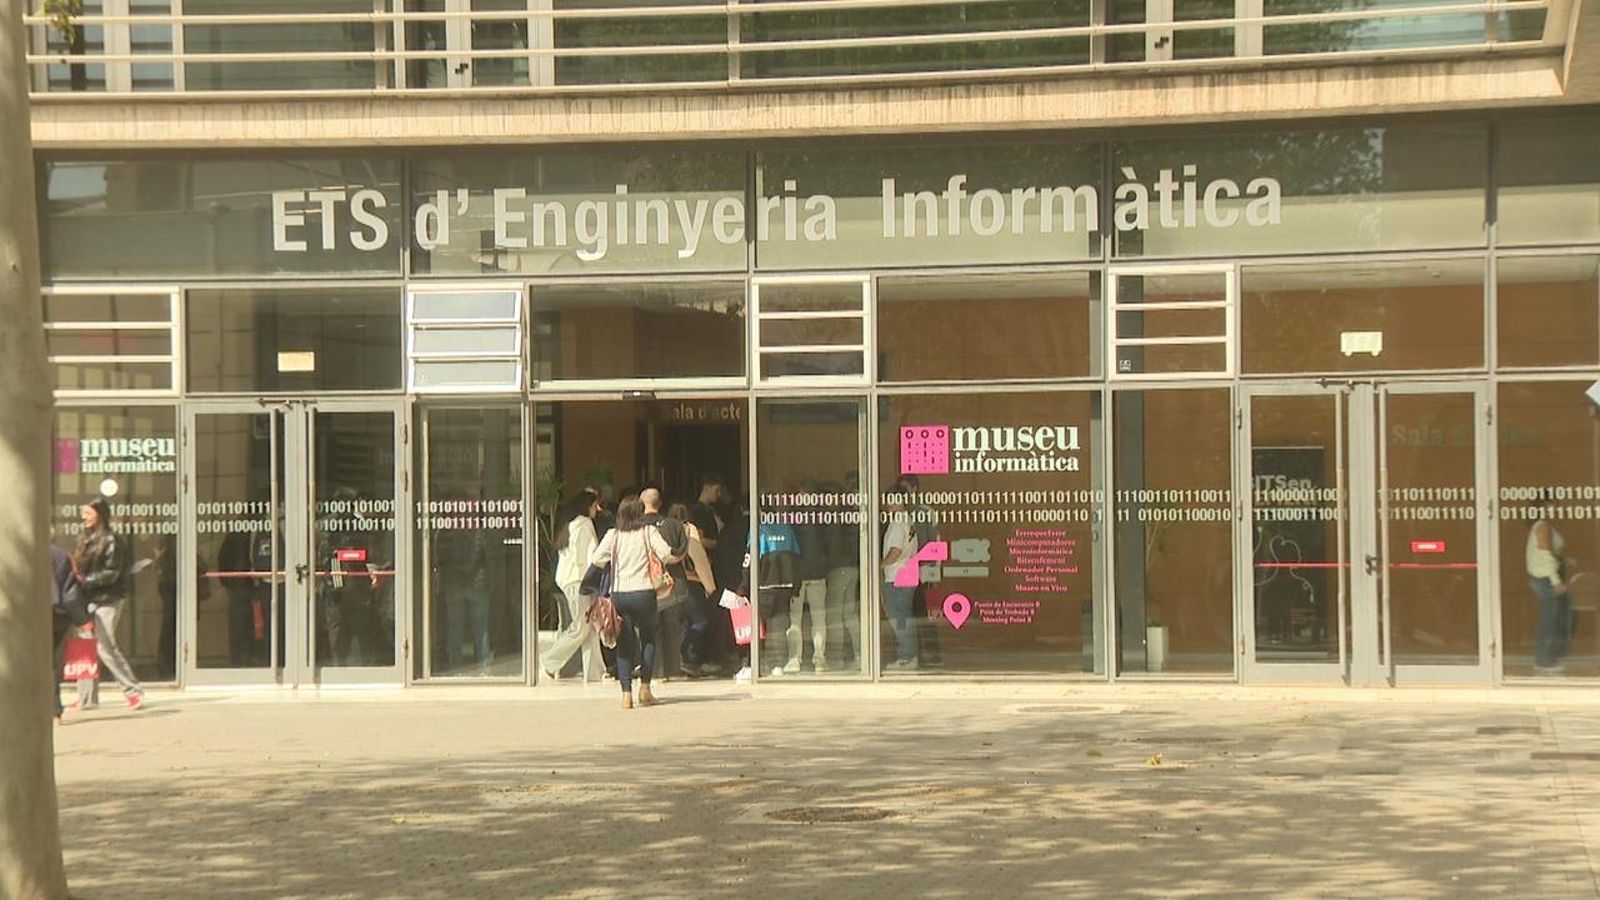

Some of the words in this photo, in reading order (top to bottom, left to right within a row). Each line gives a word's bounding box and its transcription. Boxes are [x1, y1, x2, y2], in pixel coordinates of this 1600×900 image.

[272, 188, 389, 251] ETS
[415, 188, 469, 251] d'
[494, 179, 837, 262] Enginyeria
[881, 164, 1282, 239] Informàtica
[80, 438, 176, 457] museu
[953, 425, 1081, 451] museu
[82, 456, 176, 473] informàtica
[955, 451, 1080, 472] informàtica
